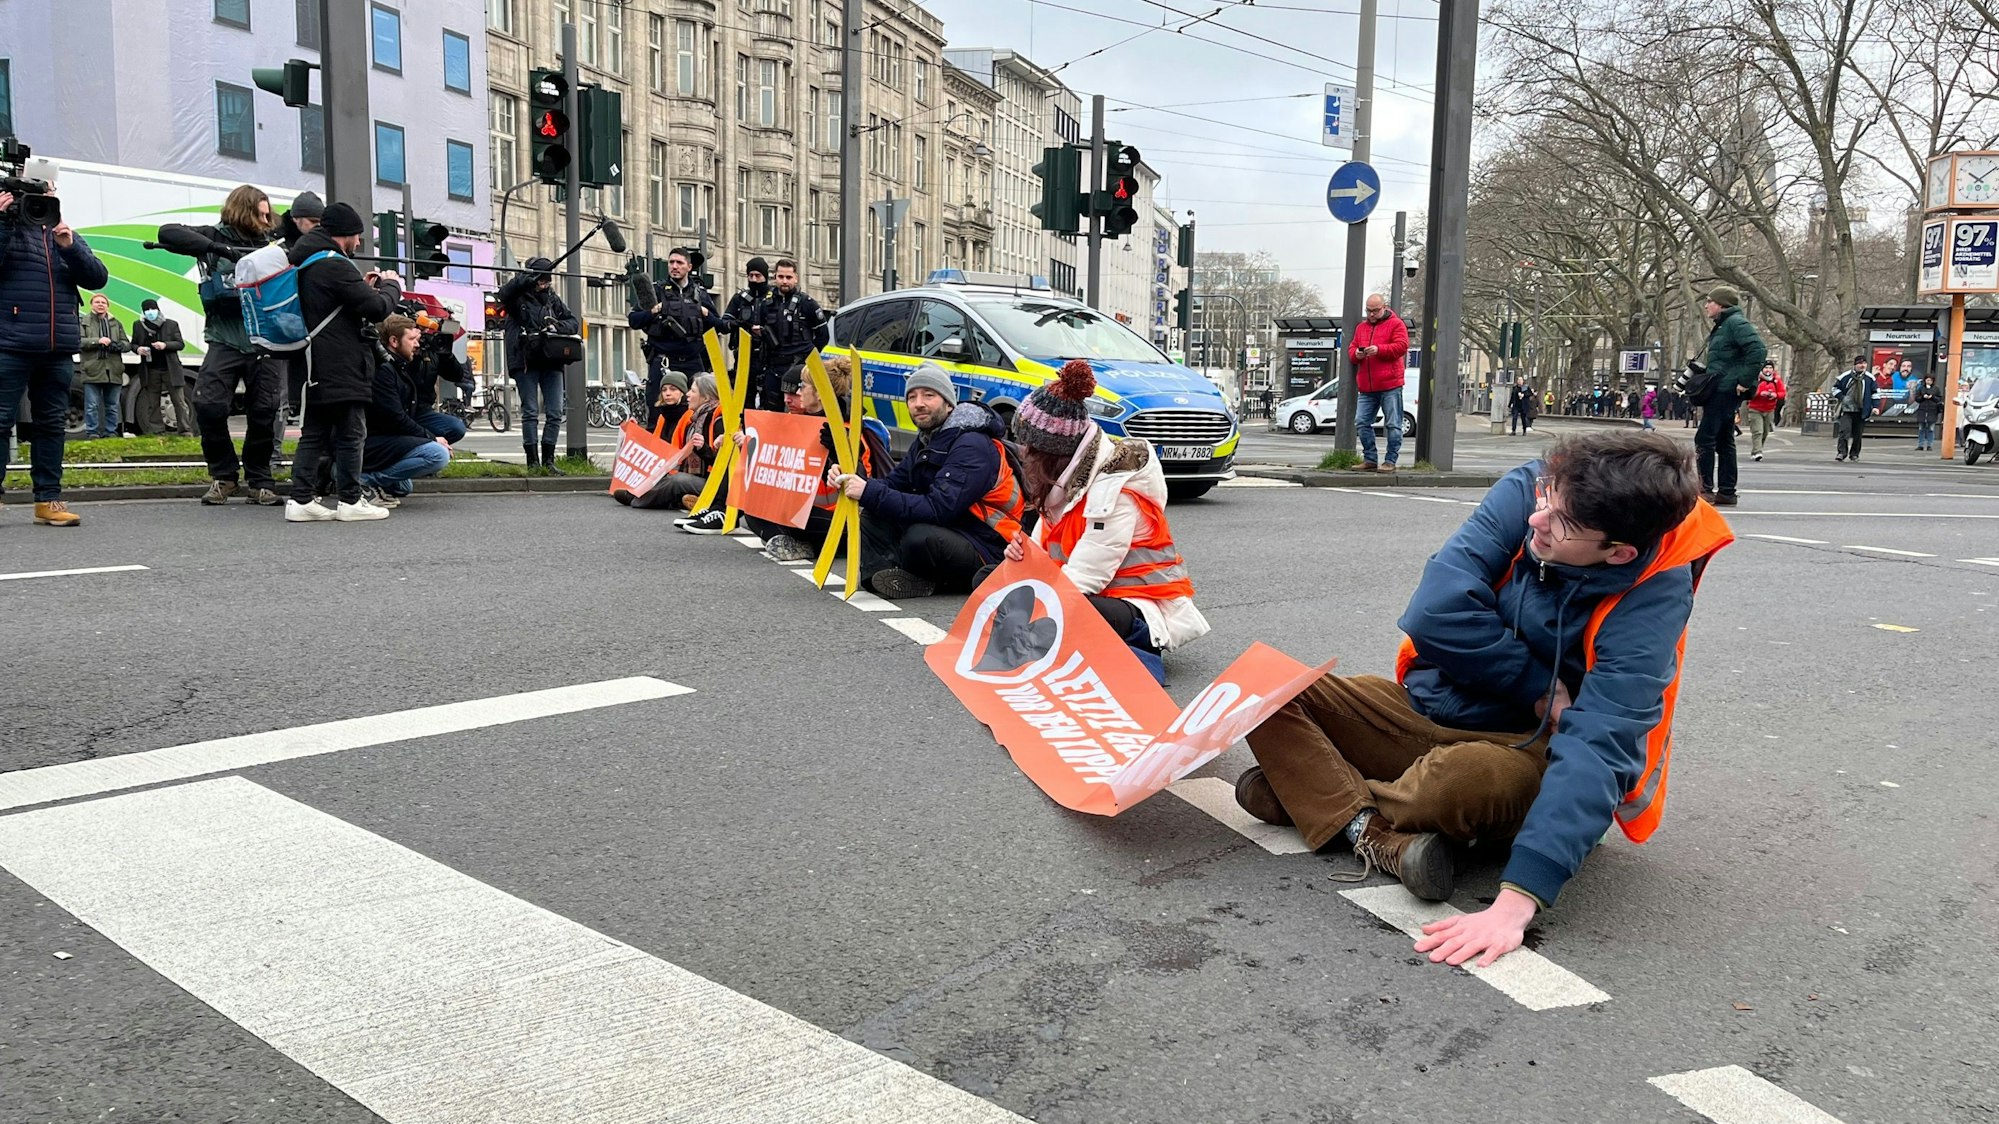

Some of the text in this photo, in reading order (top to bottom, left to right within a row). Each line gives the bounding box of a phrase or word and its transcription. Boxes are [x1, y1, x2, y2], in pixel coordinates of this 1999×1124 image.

[620, 439, 660, 473] LETZTE
[994, 682, 1055, 712] VOR
[1041, 650, 1144, 732] LETZTE
[1020, 711, 1087, 739] DEN
